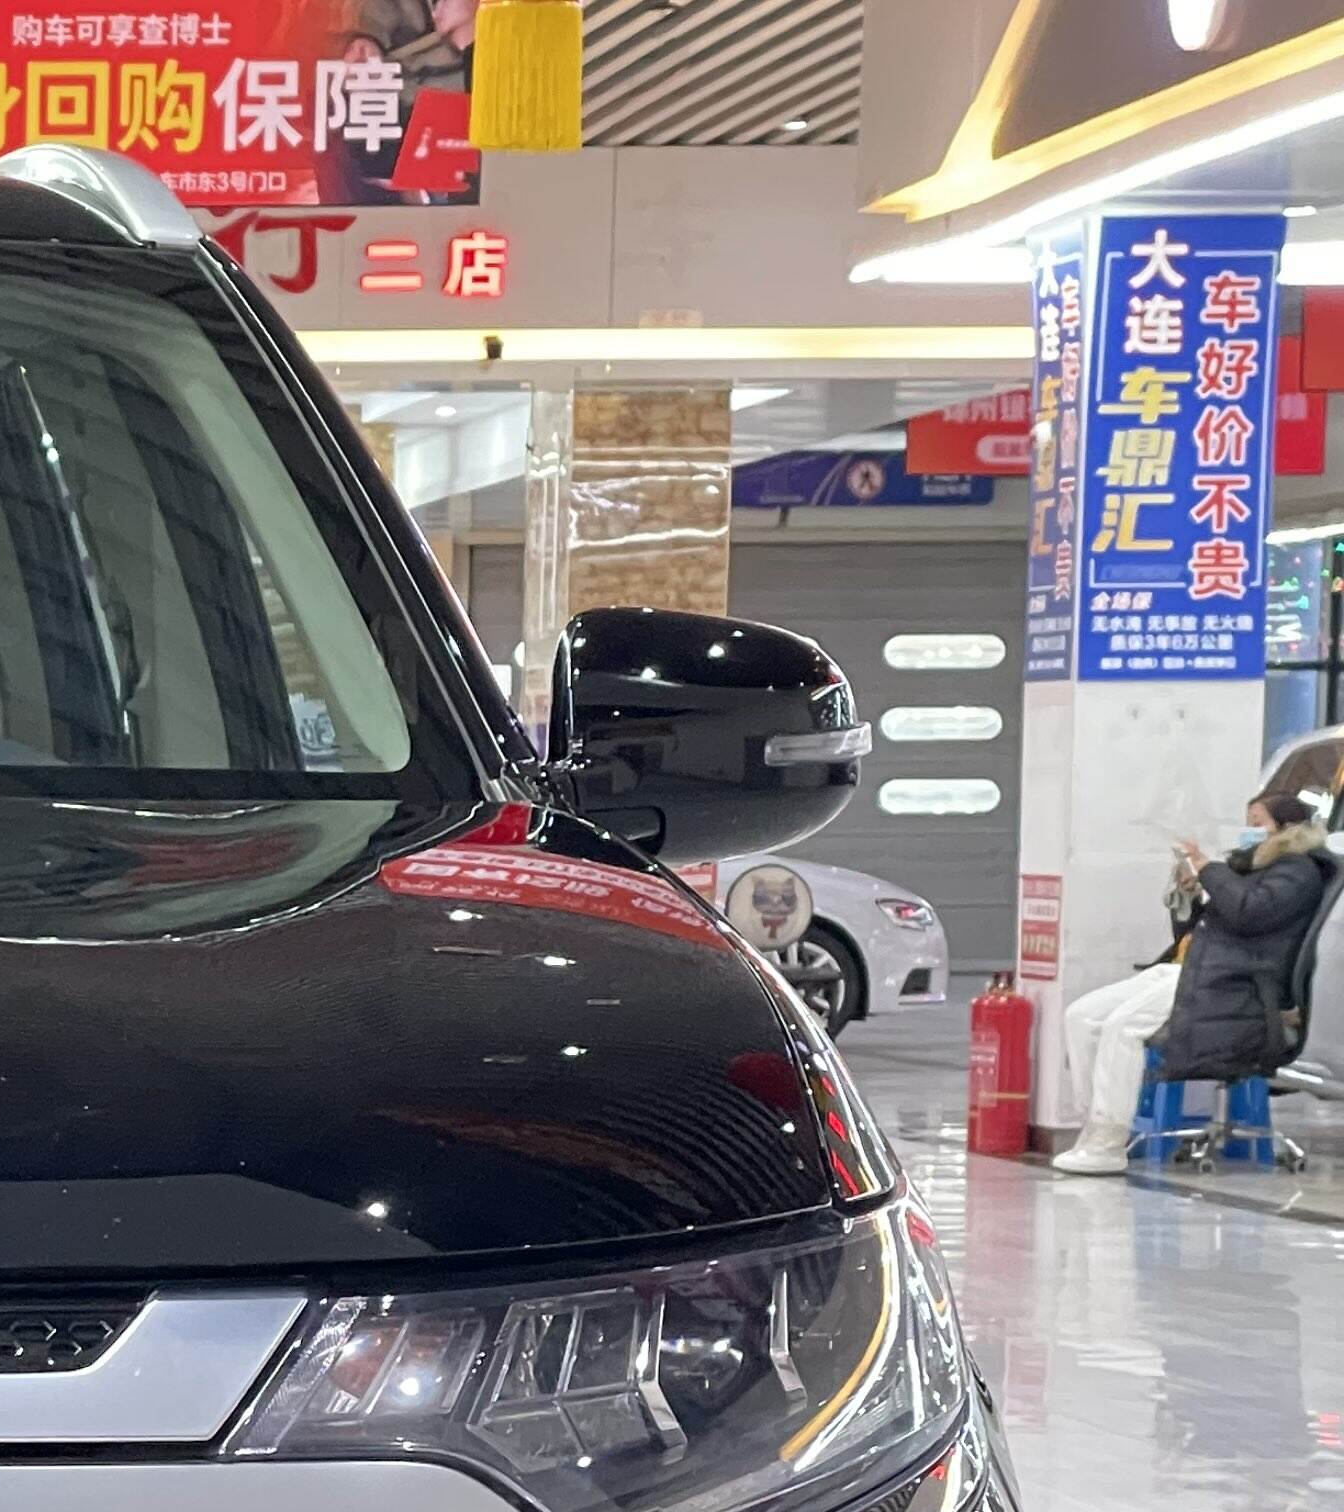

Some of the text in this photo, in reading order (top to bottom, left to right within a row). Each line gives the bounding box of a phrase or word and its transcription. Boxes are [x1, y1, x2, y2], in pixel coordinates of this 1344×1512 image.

[12, 14, 232, 48] 购车可享查博士
[360, 231, 508, 298] 二店
[1090, 228, 1192, 553] 大连车鼎汇
[1187, 269, 1261, 600] 车好价不贵
